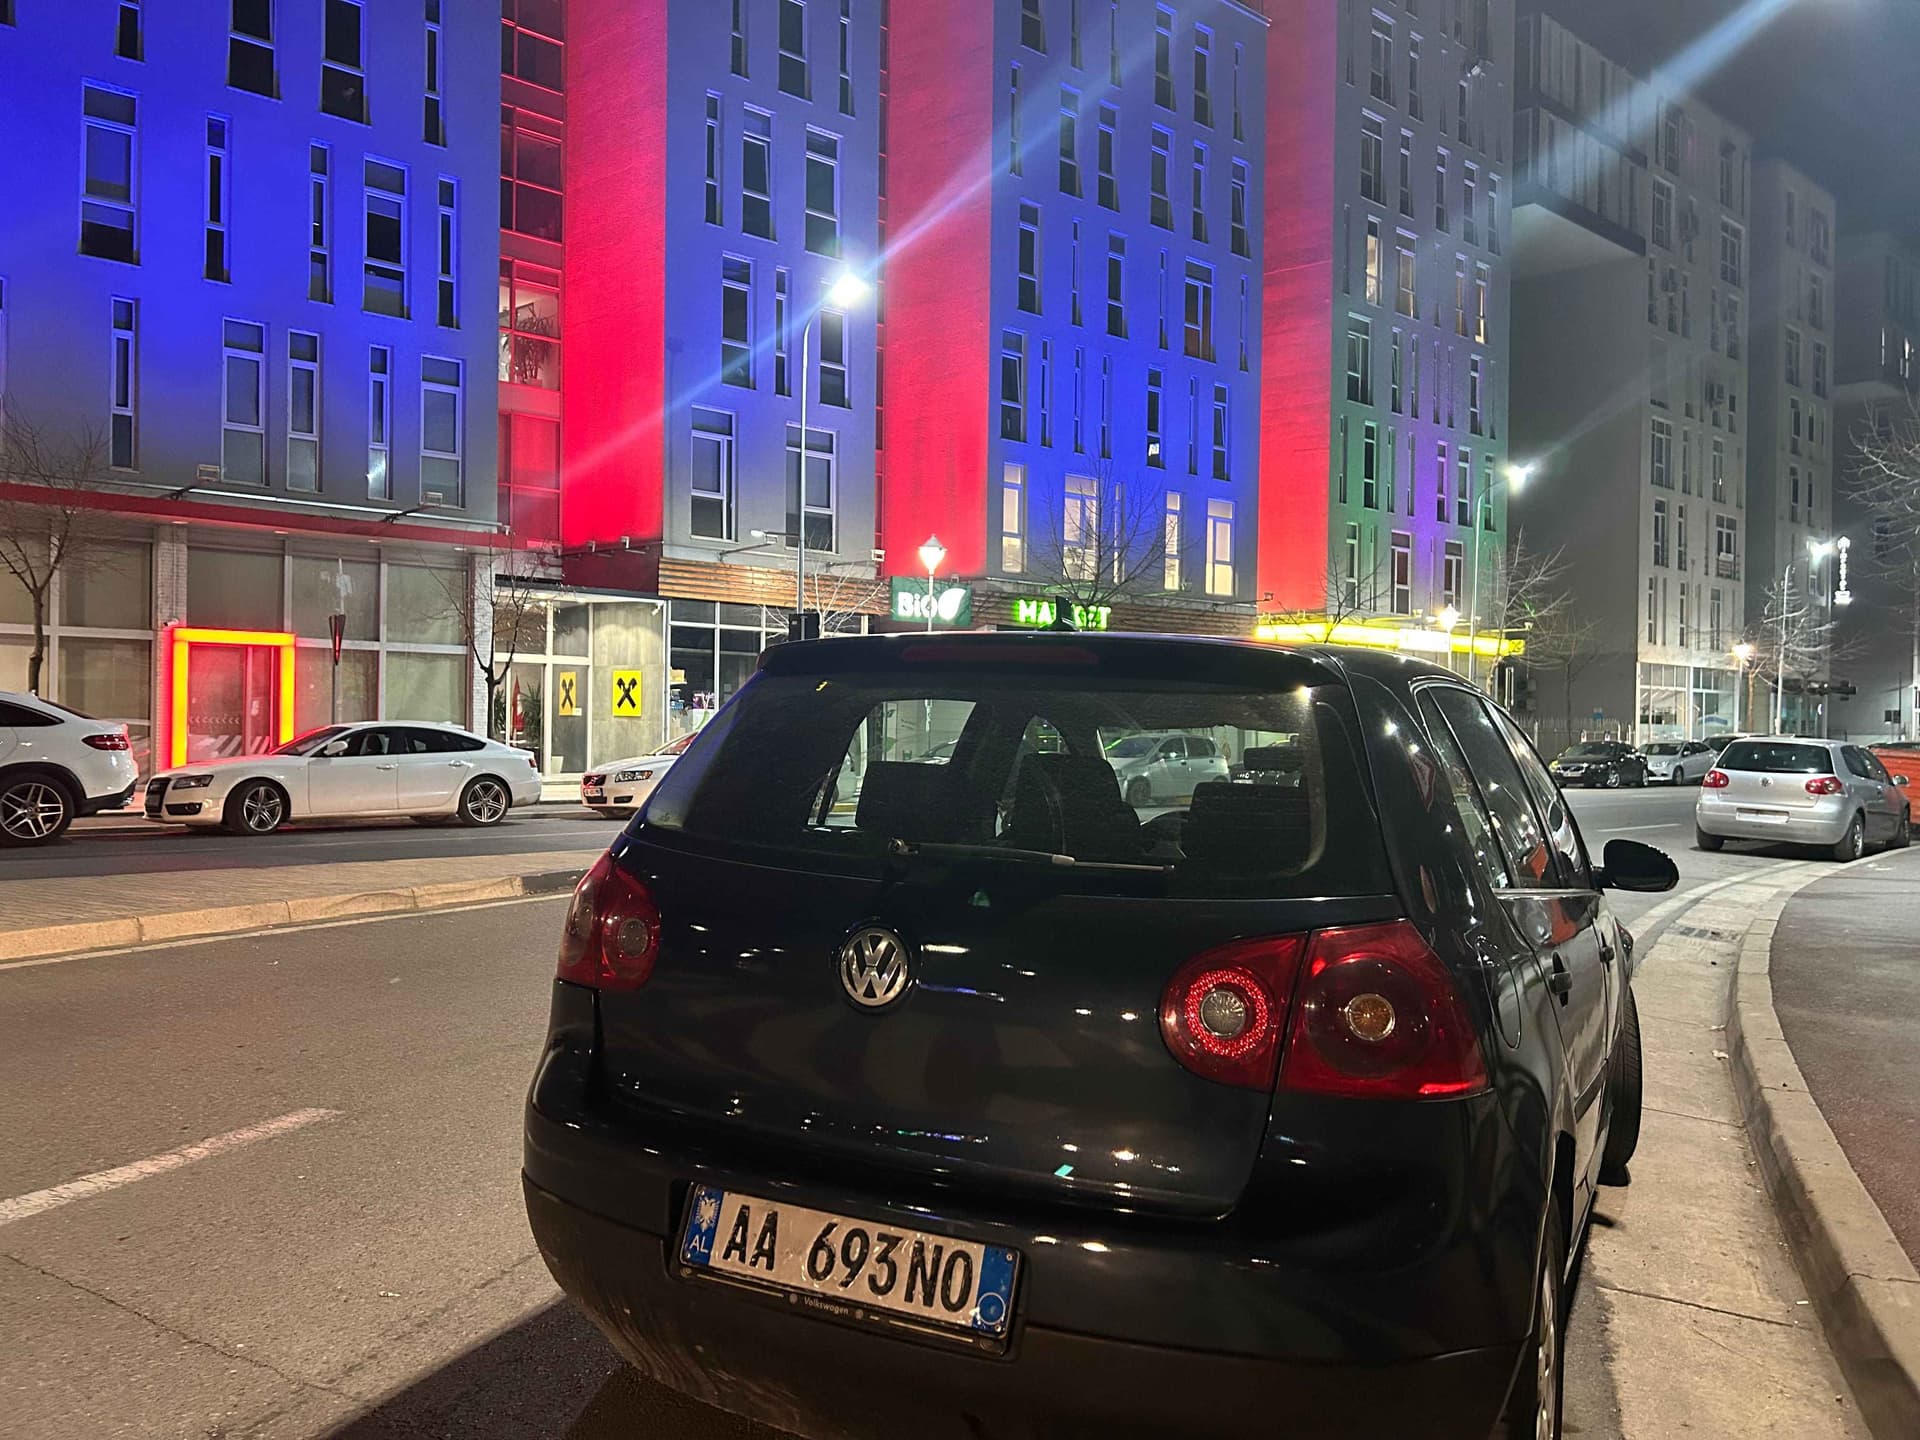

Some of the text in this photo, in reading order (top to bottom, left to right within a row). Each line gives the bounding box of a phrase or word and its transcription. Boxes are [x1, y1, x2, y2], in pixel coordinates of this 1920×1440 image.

[689, 1233, 709, 1254] AL
[723, 1204, 778, 1271] AA
[804, 1296, 849, 1315] Volkswagen
